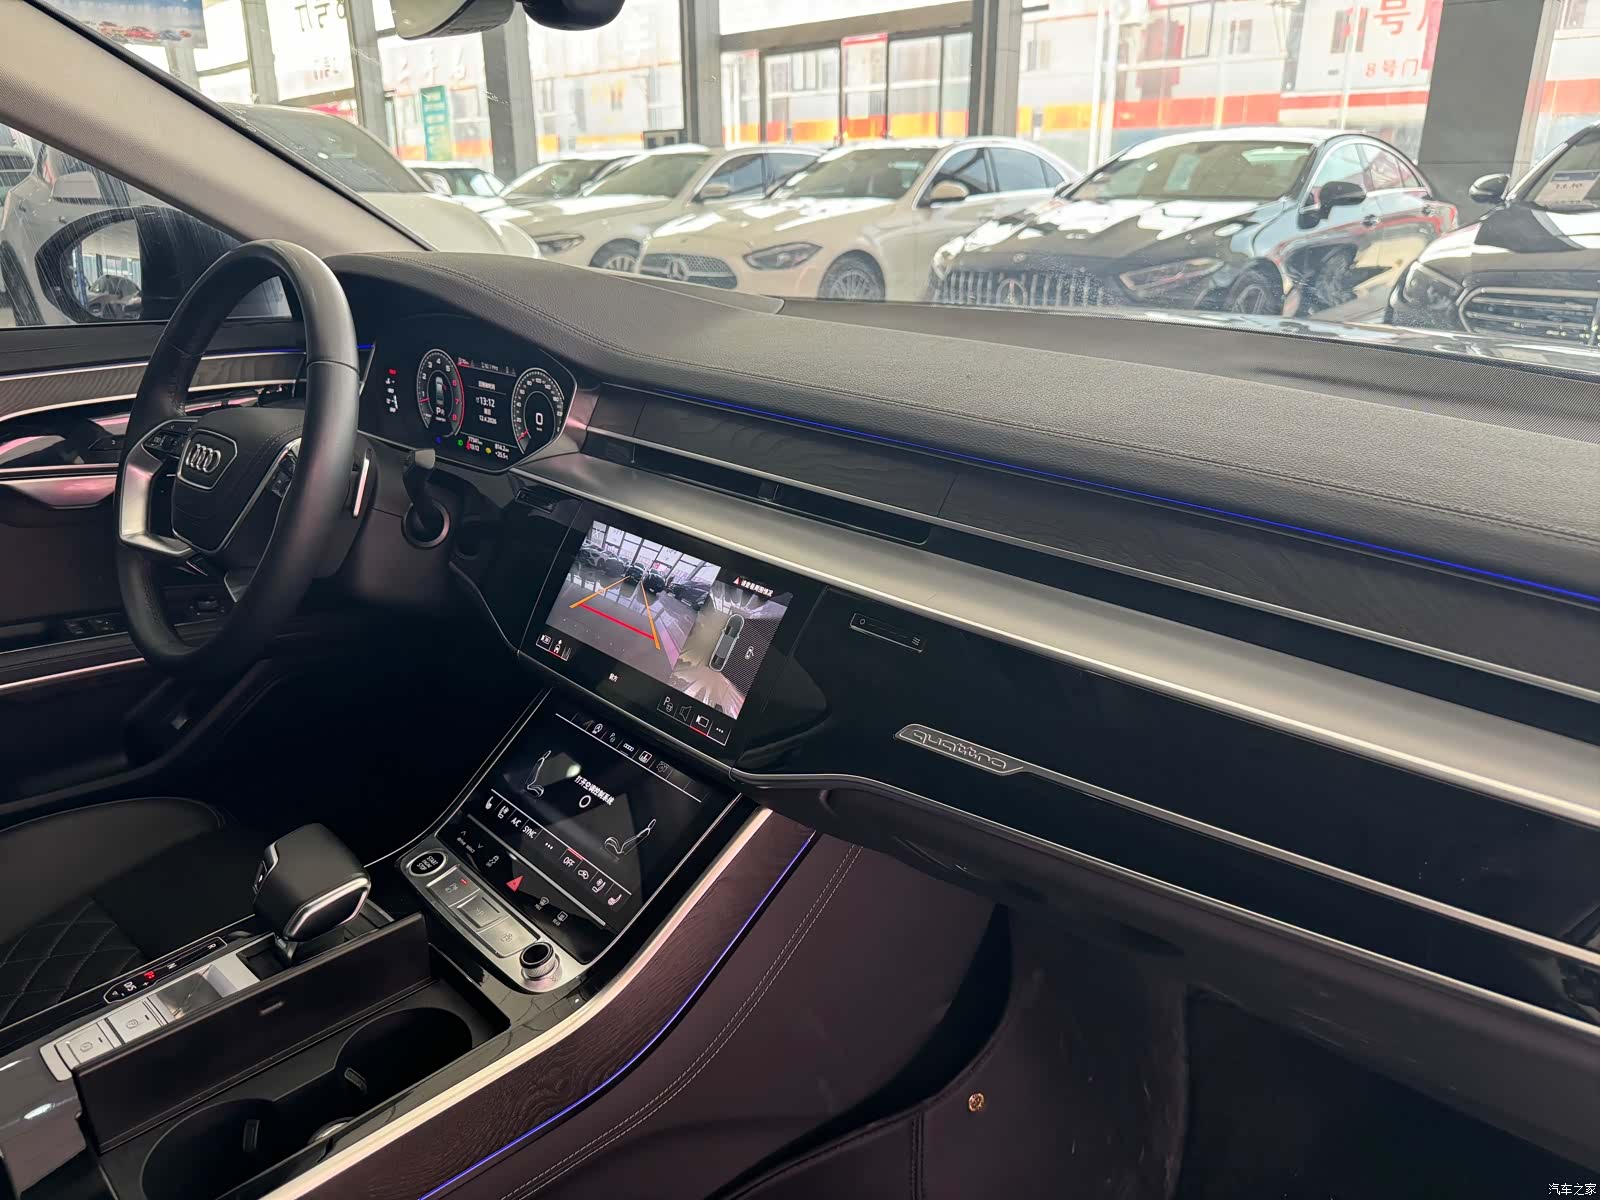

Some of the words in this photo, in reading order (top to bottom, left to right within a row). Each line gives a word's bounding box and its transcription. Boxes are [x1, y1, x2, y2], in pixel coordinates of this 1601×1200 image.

[479, 396, 496, 408] 13:12
[535, 412, 544, 426] 0
[913, 729, 1007, 769] quattro
[573, 775, 616, 806] 打开空调控制系统
[522, 825, 538, 839] SYNC
[426, 855, 439, 866] START
[562, 856, 576, 868] OFF
